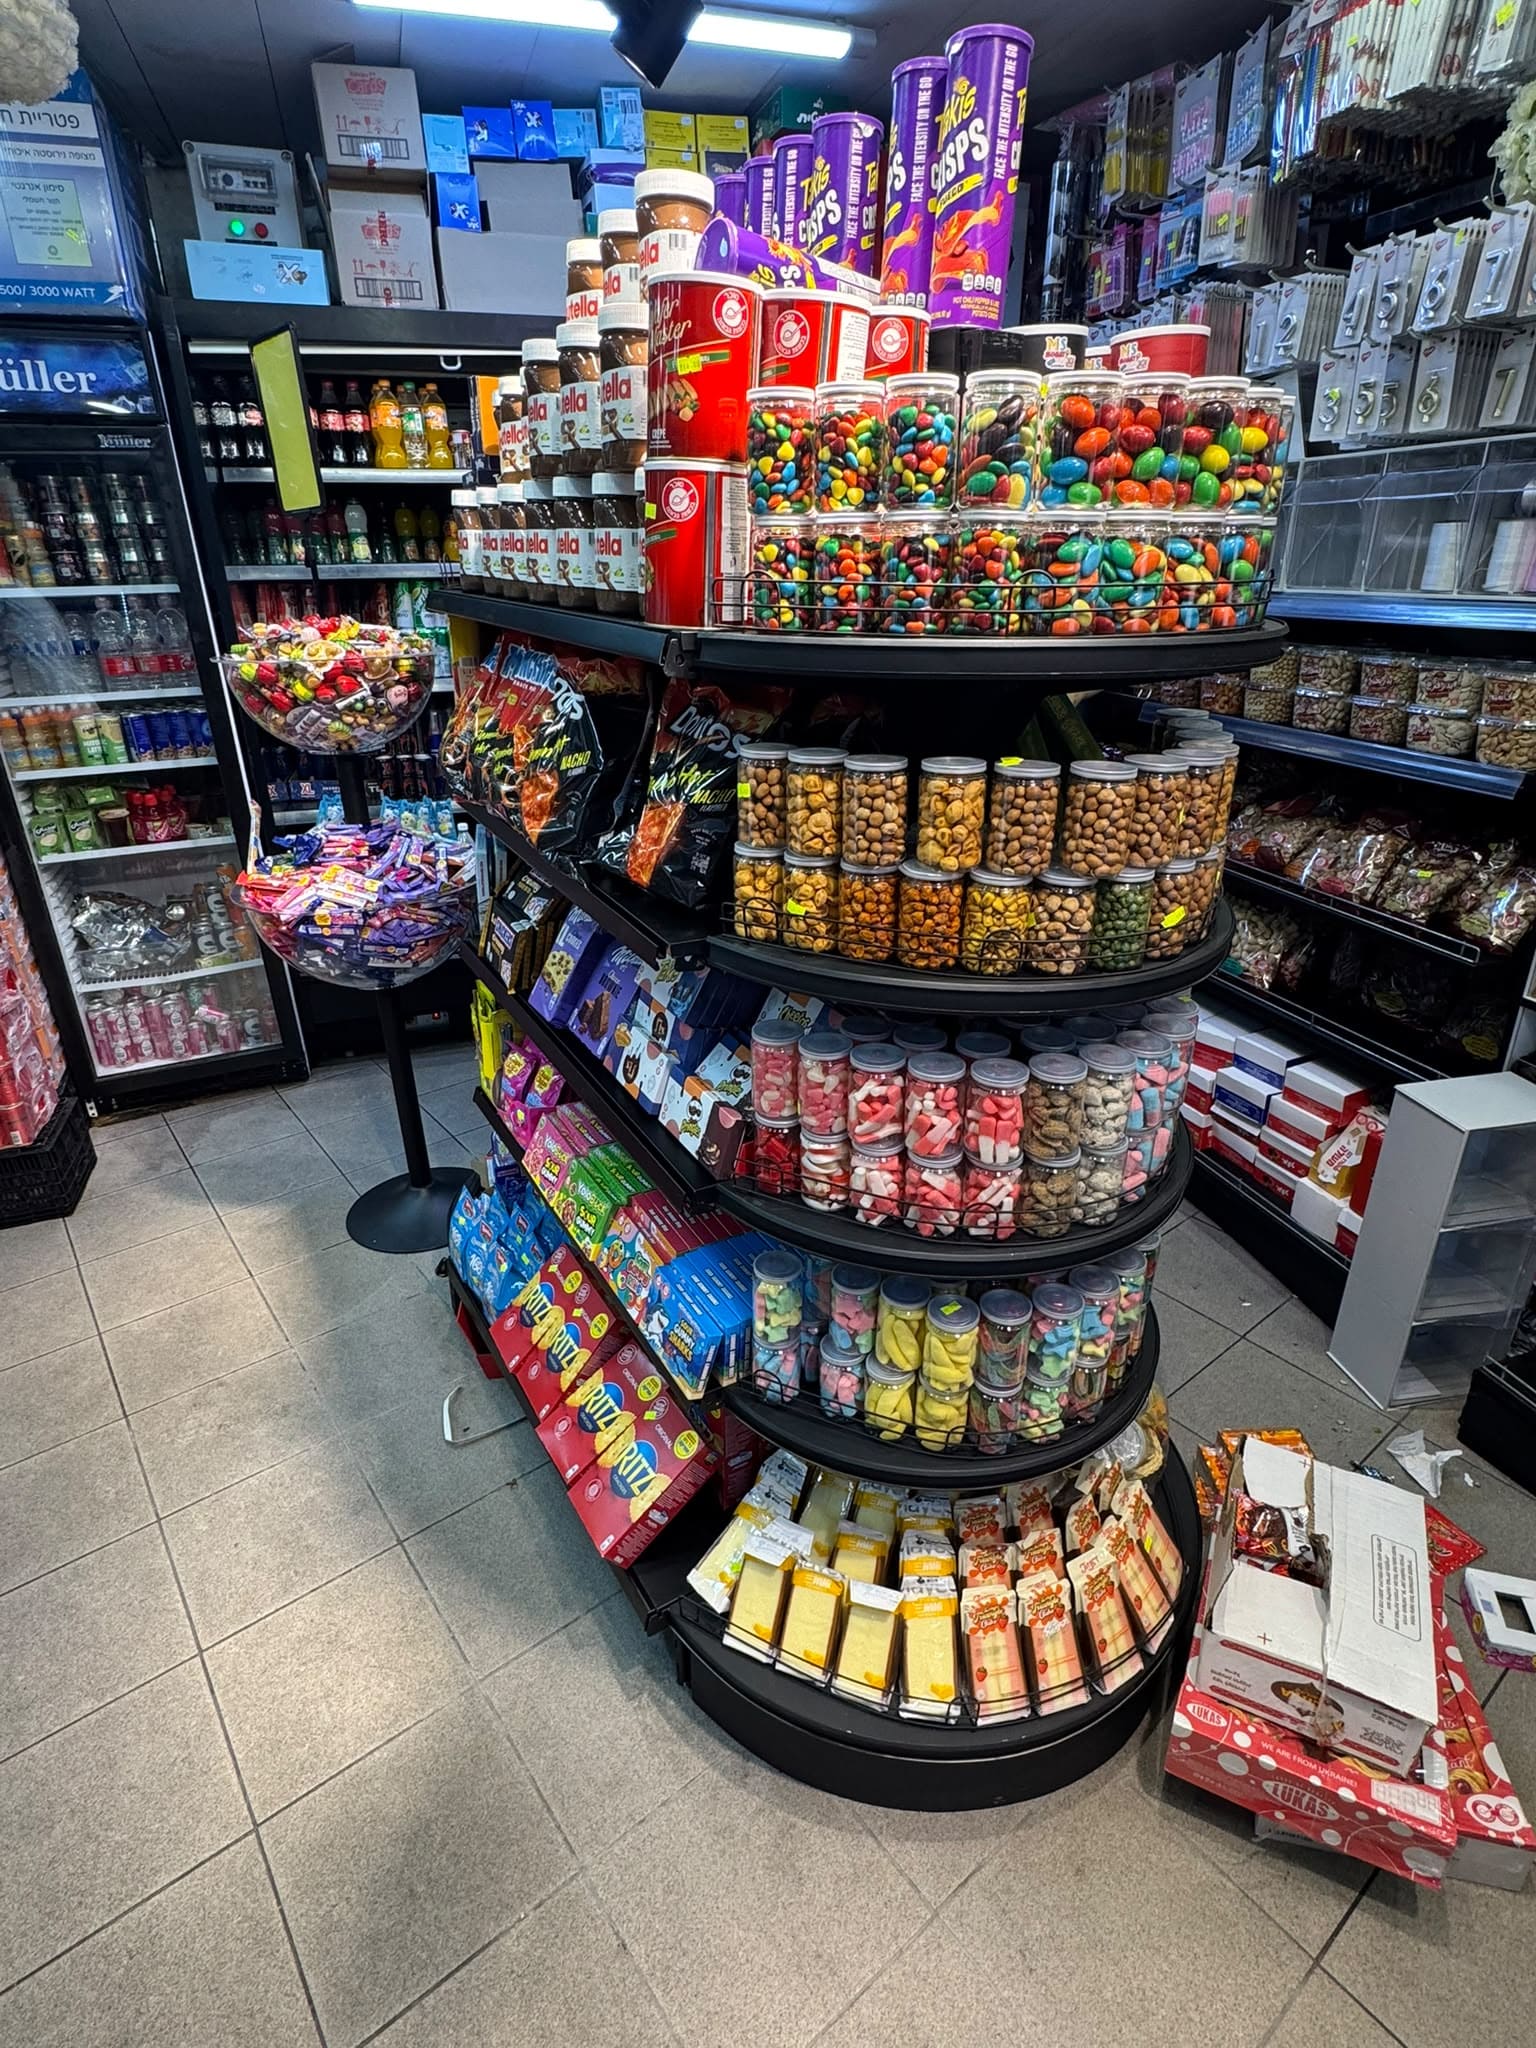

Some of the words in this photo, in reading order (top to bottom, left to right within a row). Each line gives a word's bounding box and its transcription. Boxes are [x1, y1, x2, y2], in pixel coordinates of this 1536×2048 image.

[1005, 43, 1018, 57] GO
[1003, 58, 1017, 76] THE
[920, 77, 933, 89] GO
[1002, 76, 1015, 91] ON
[20, 109, 80, 129] פטריית
[998, 90, 1013, 138] INTENSITY
[995, 137, 1009, 156] THE
[912, 163, 925, 183] THE
[993, 155, 1007, 180] FACE
[910, 182, 924, 202] FACE
[847, 220, 858, 239] FACE
[29, 285, 60, 297] 3000
[60, 286, 96, 298] WATT
[567, 295, 598, 322] tella
[0, 358, 97, 393] üller
[601, 371, 632, 404] tella
[528, 402, 548, 422] ella
[561, 387, 587, 415] tella
[526, 531, 549, 554] ella
[557, 531, 580, 555] ella
[560, 750, 591, 770] NACHO
[300, 782, 316, 795] XL
[690, 789, 737, 804] NACHO
[522, 1286, 554, 1320] RITZ
[548, 1327, 581, 1370] RITZ
[580, 1390, 621, 1432] RITZ
[653, 1424, 673, 1449] ORIGINAL
[612, 1444, 658, 1498] RITZ
[1191, 1704, 1222, 1725] LUKAS
[1260, 1741, 1274, 1751] WE
[1275, 1748, 1291, 1759] ARE
[1292, 1755, 1318, 1771] FROM
[1318, 1765, 1358, 1787] UKRAINE!
[1271, 1781, 1329, 1817] LUKAS
